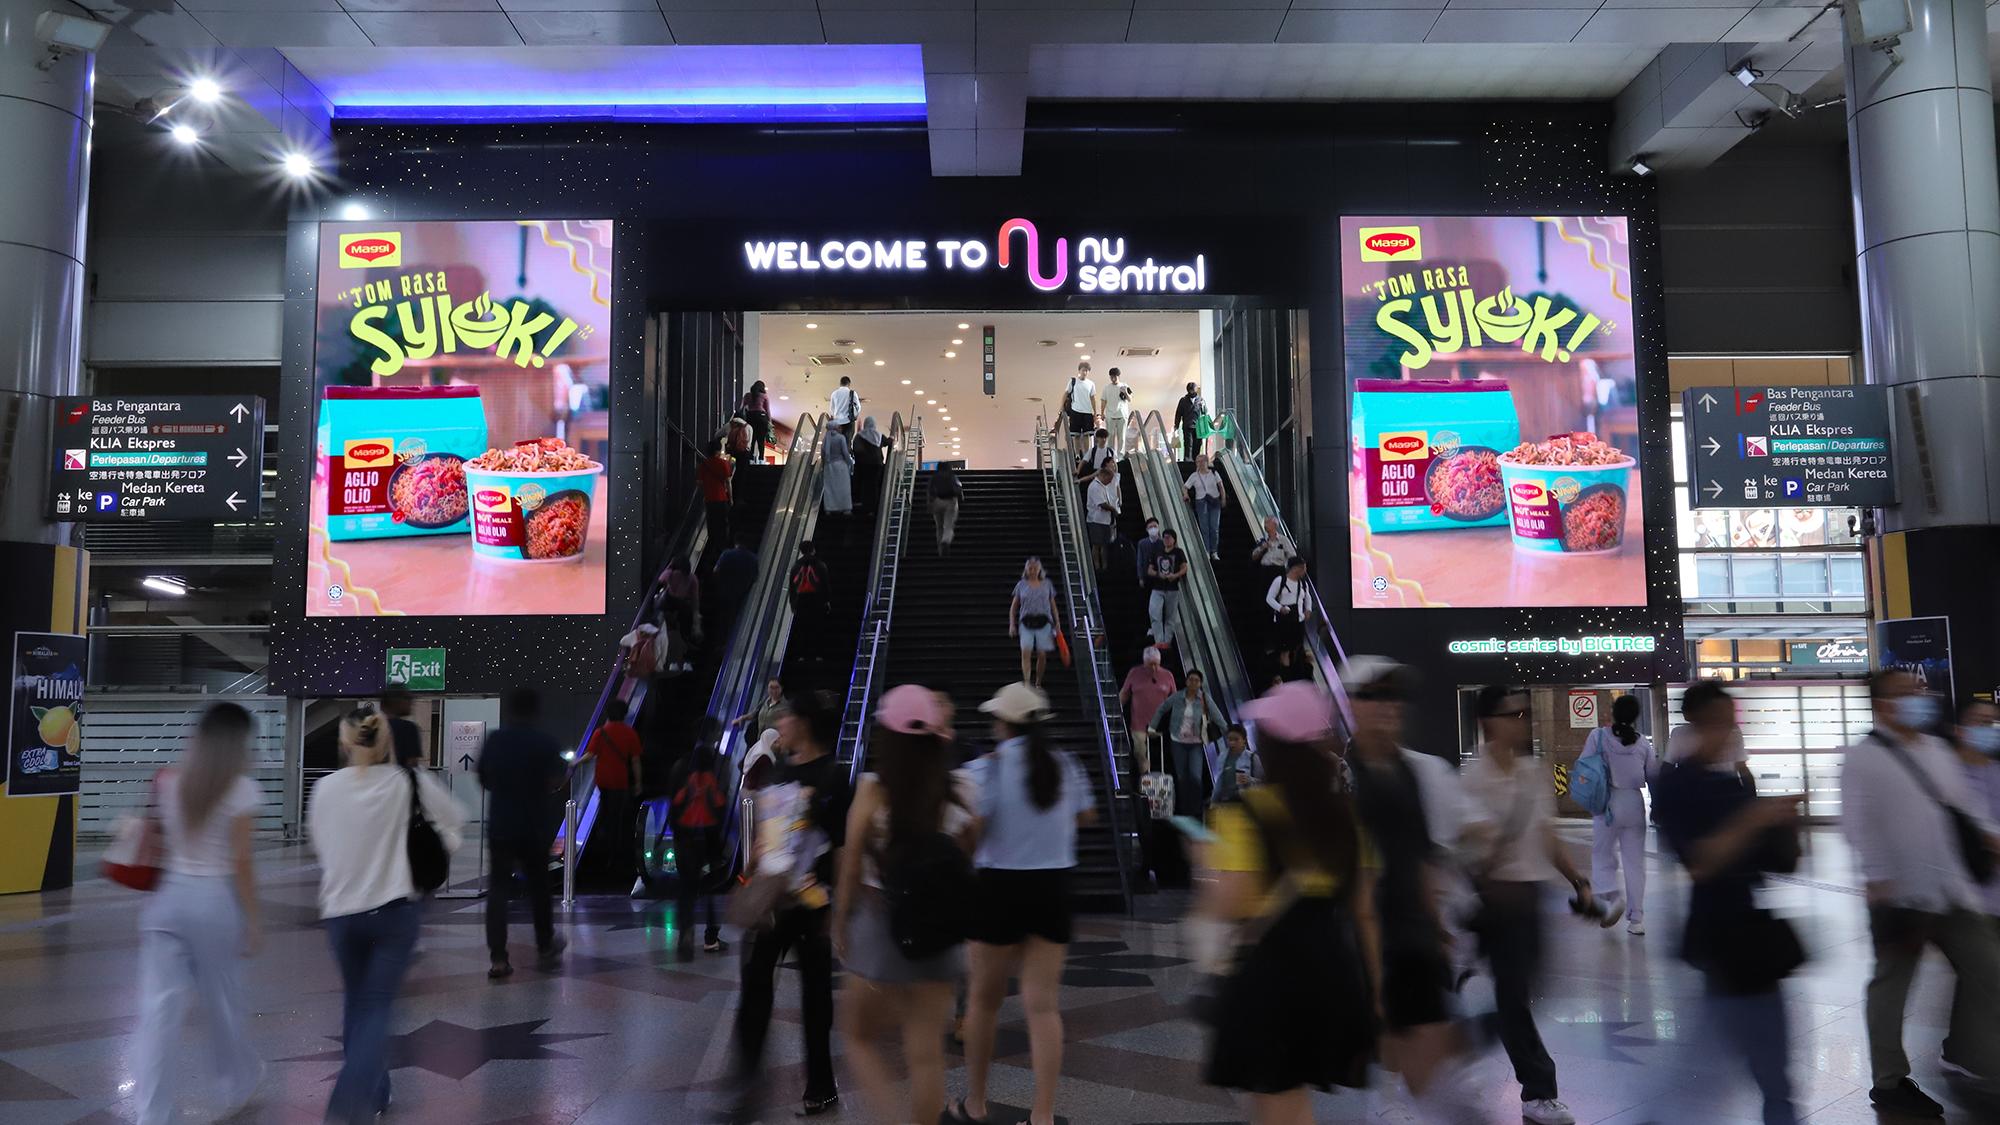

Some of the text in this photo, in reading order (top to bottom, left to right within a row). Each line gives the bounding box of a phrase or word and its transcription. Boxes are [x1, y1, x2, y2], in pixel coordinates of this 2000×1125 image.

[351, 244, 390, 254] Maggi
[1371, 238, 1410, 248] Maggi
[744, 241, 987, 270] WELCOME TO
[1078, 237, 1125, 263] nu
[1079, 254, 1205, 291] sentral
[1767, 388, 1854, 401] Bas Pengantara
[92, 400, 181, 414] Bas Pengantara
[1768, 402, 1822, 411] Feeder Bus
[92, 415, 146, 424] Feeder Bus
[1769, 424, 1854, 438] KLIA Ekspres
[90, 437, 176, 451] KLIA Ekspres
[1805, 467, 1887, 480] Medan Kereta
[1763, 475, 1778, 486] ke
[121, 482, 205, 494] Medan Kereta
[1786, 481, 1798, 495] P
[1806, 482, 1850, 492] Car Park
[78, 489, 93, 500] ke
[1765, 490, 1775, 499] to
[100, 495, 113, 510] P
[121, 496, 166, 507] Car Park
[78, 504, 88, 514] to
[1450, 636, 1655, 655] cosmic series by BIGTREE
[411, 661, 441, 677] Exit
[21, 747, 46, 759] EXTRA
[23, 757, 46, 769] COOL
